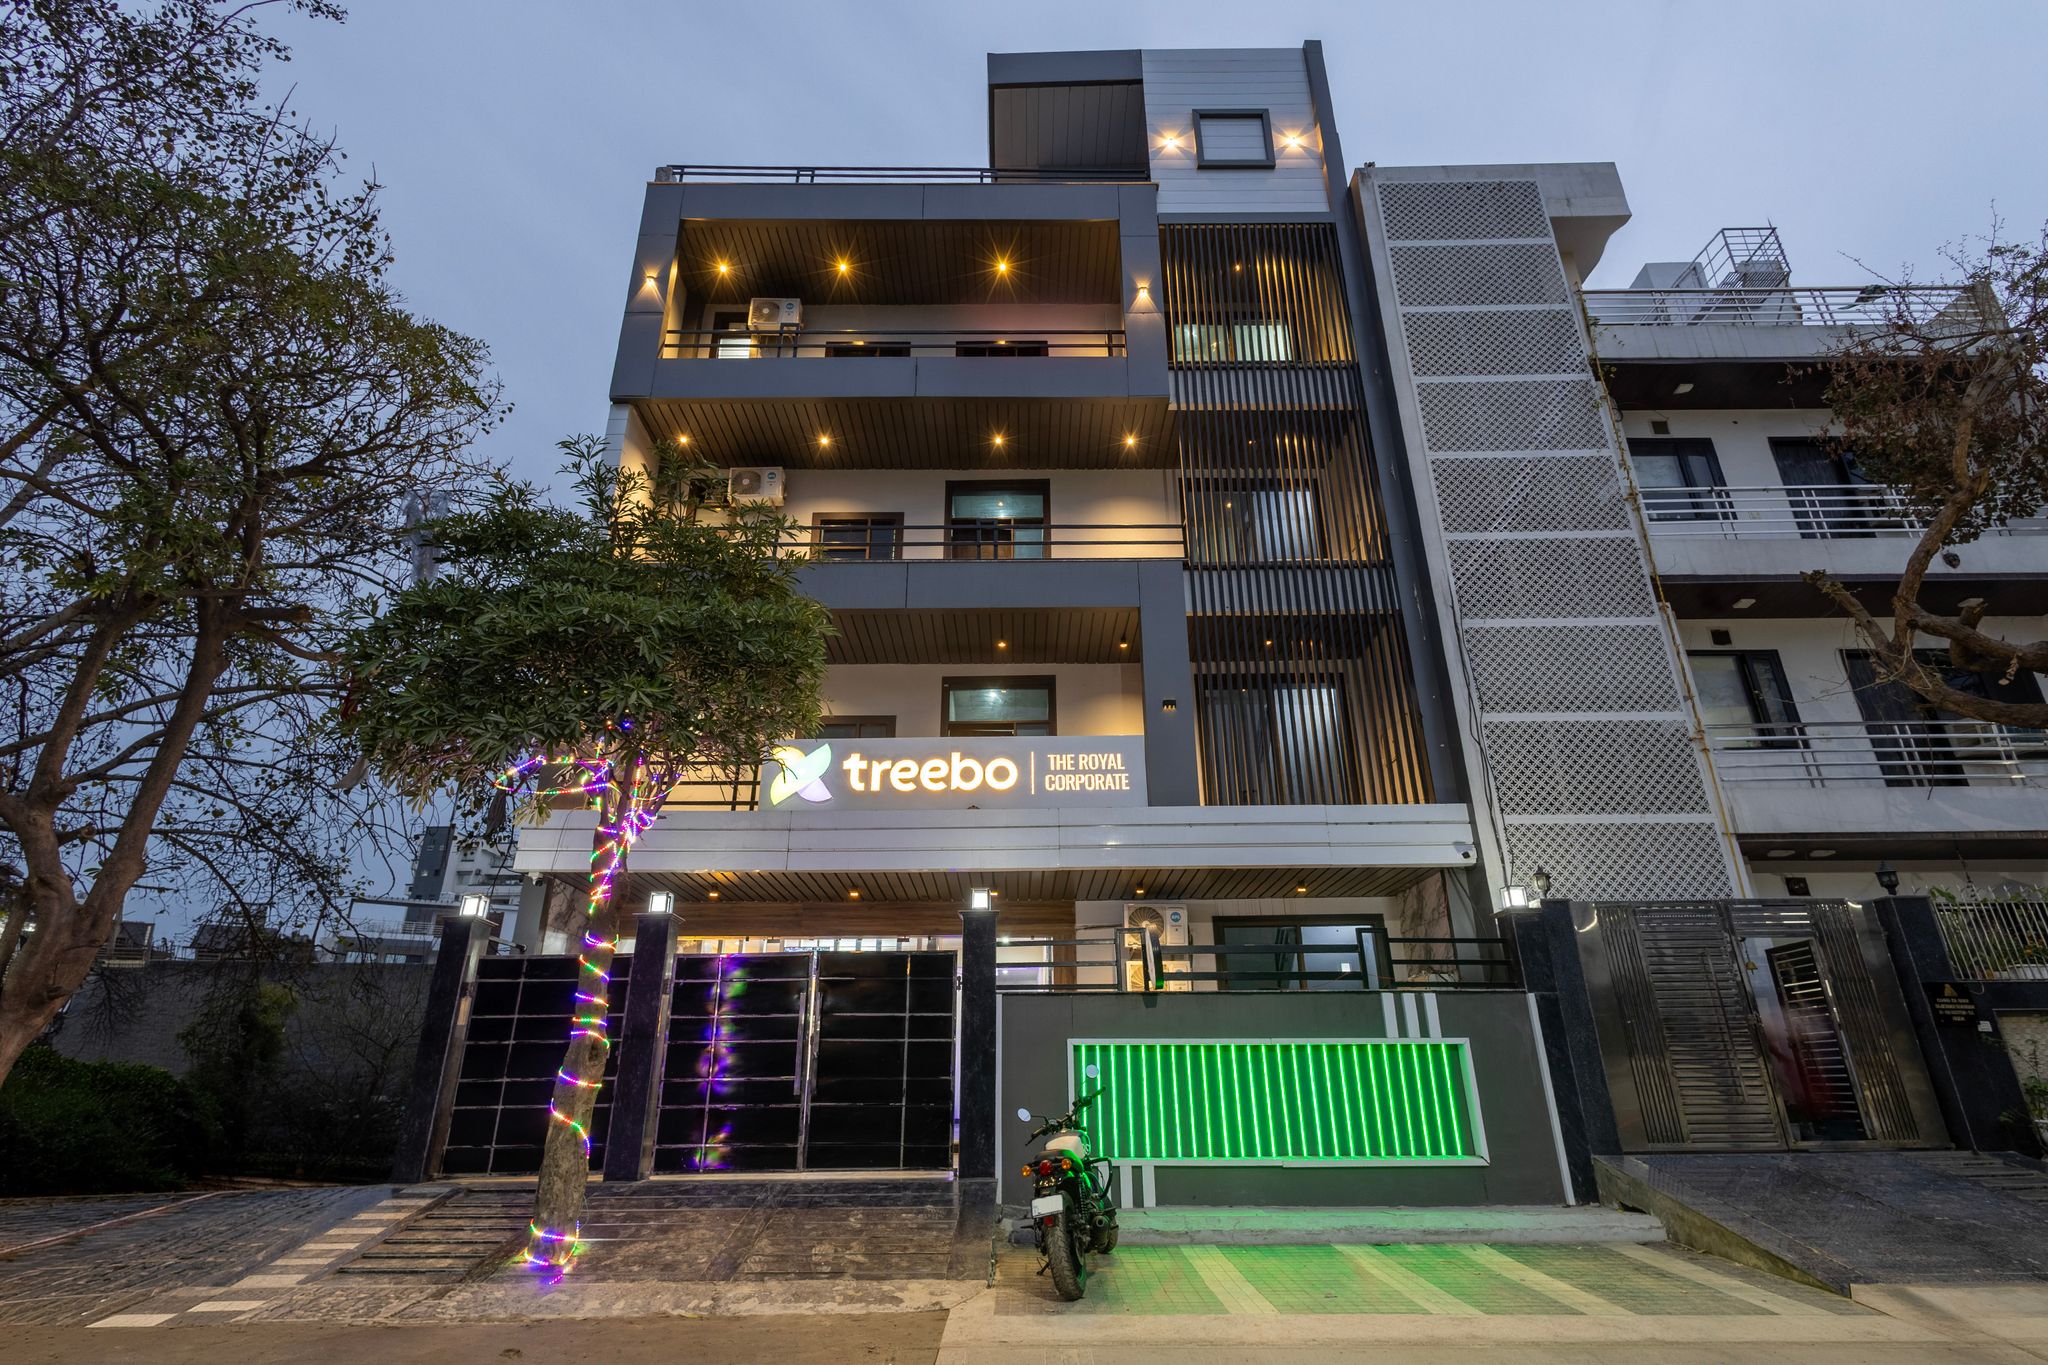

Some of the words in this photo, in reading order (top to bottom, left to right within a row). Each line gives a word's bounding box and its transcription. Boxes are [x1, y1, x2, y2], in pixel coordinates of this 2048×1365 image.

[1047, 754, 1074, 771] THE
[1078, 753, 1126, 771] ROYAL
[842, 752, 1019, 792] treebo
[1044, 773, 1131, 791] CORPORATE
